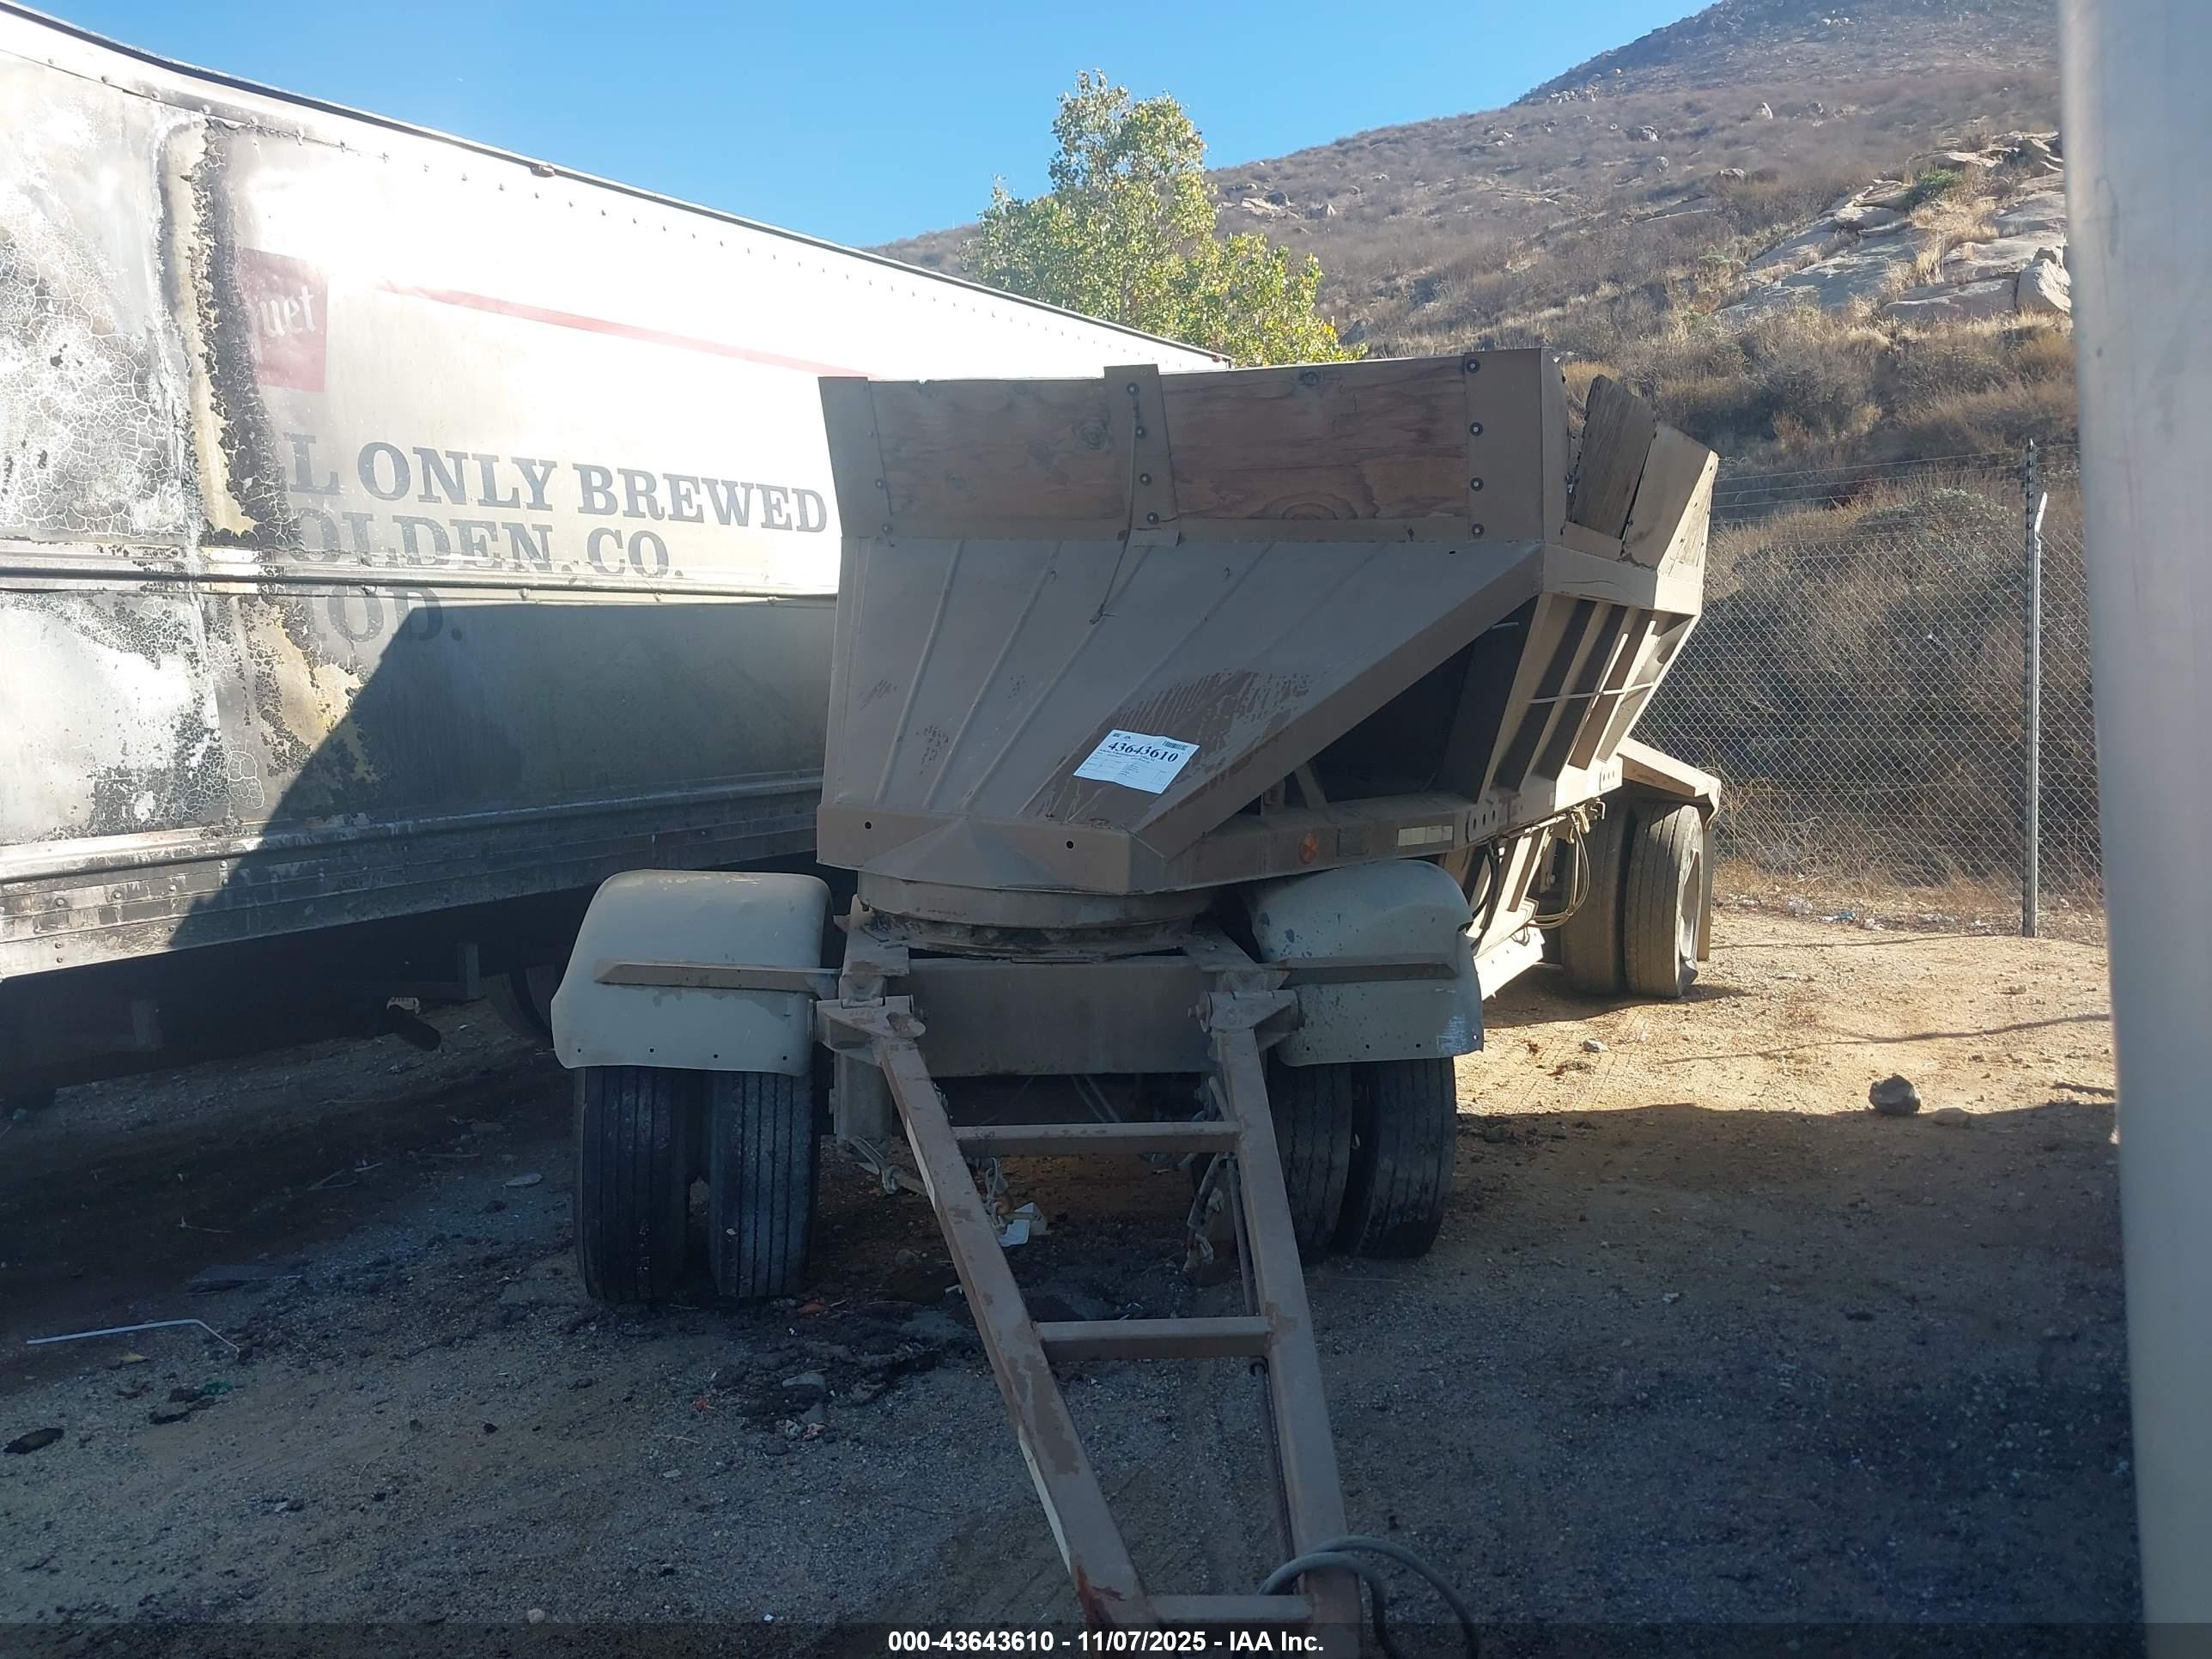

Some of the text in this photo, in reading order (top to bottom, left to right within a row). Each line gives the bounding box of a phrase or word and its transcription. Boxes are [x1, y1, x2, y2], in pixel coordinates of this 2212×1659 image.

[357, 441, 557, 512] ONLY
[573, 463, 827, 533] BREWED
[587, 527, 684, 578] CO.
[1108, 741, 1179, 763] 43643610
